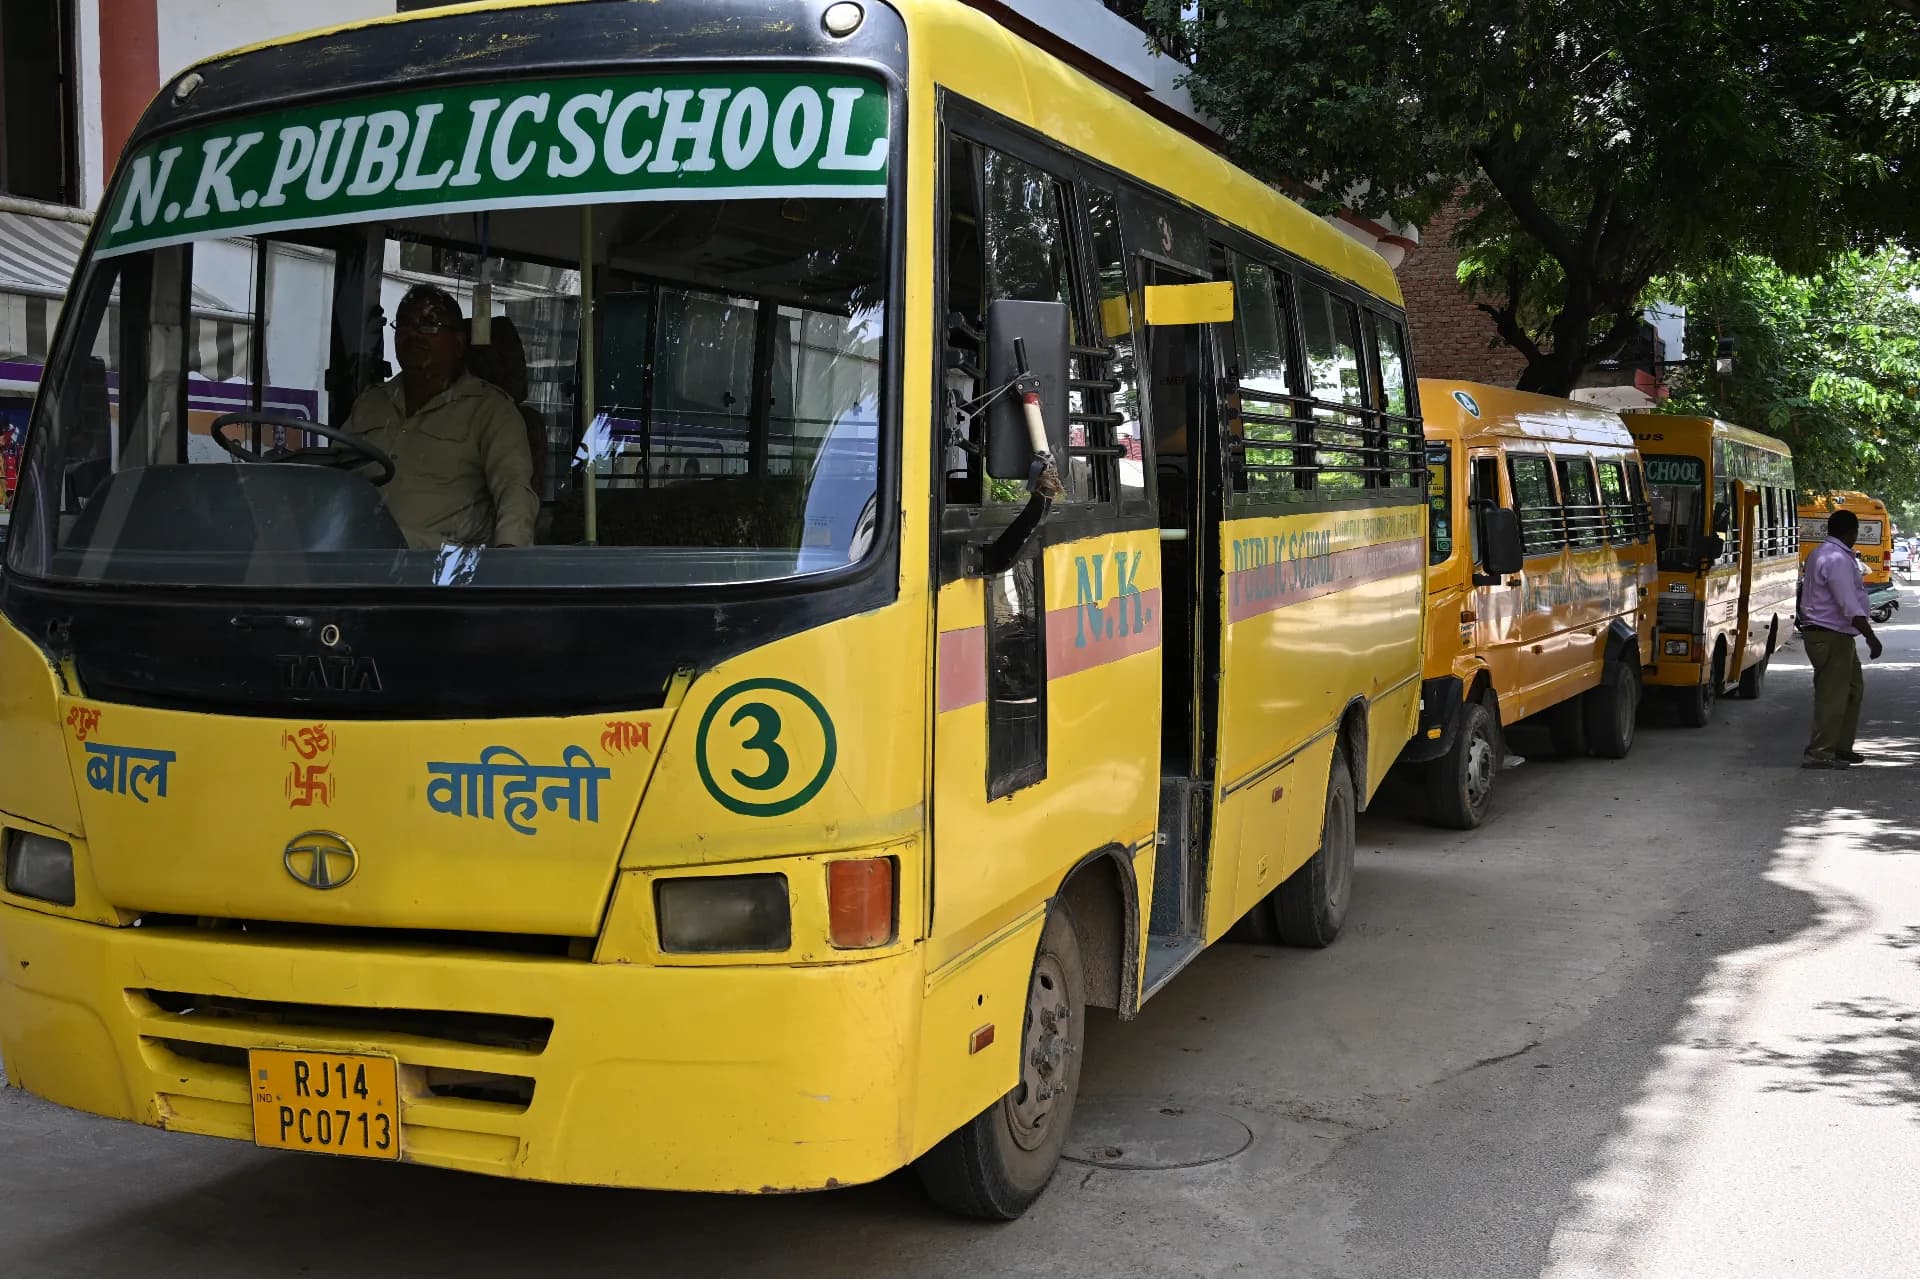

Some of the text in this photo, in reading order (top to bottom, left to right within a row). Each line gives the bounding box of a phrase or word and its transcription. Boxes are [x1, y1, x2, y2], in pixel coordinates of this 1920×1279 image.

[259, 92, 550, 207] PUBLIC
[547, 85, 888, 178] SCHOOL
[1644, 460, 1702, 481] CHOOL
[1075, 551, 1152, 648] N.K.
[1233, 530, 1286, 607] PUBLIC
[1289, 528, 1335, 593] SCHOOL
[274, 654, 383, 693] TATA
[729, 702, 790, 791] 3
[84, 741, 611, 835] बाल वाहिनी
[256, 1093, 273, 1103] IND
[294, 1060, 369, 1100] RJ14
[279, 1105, 392, 1150] PC0713
